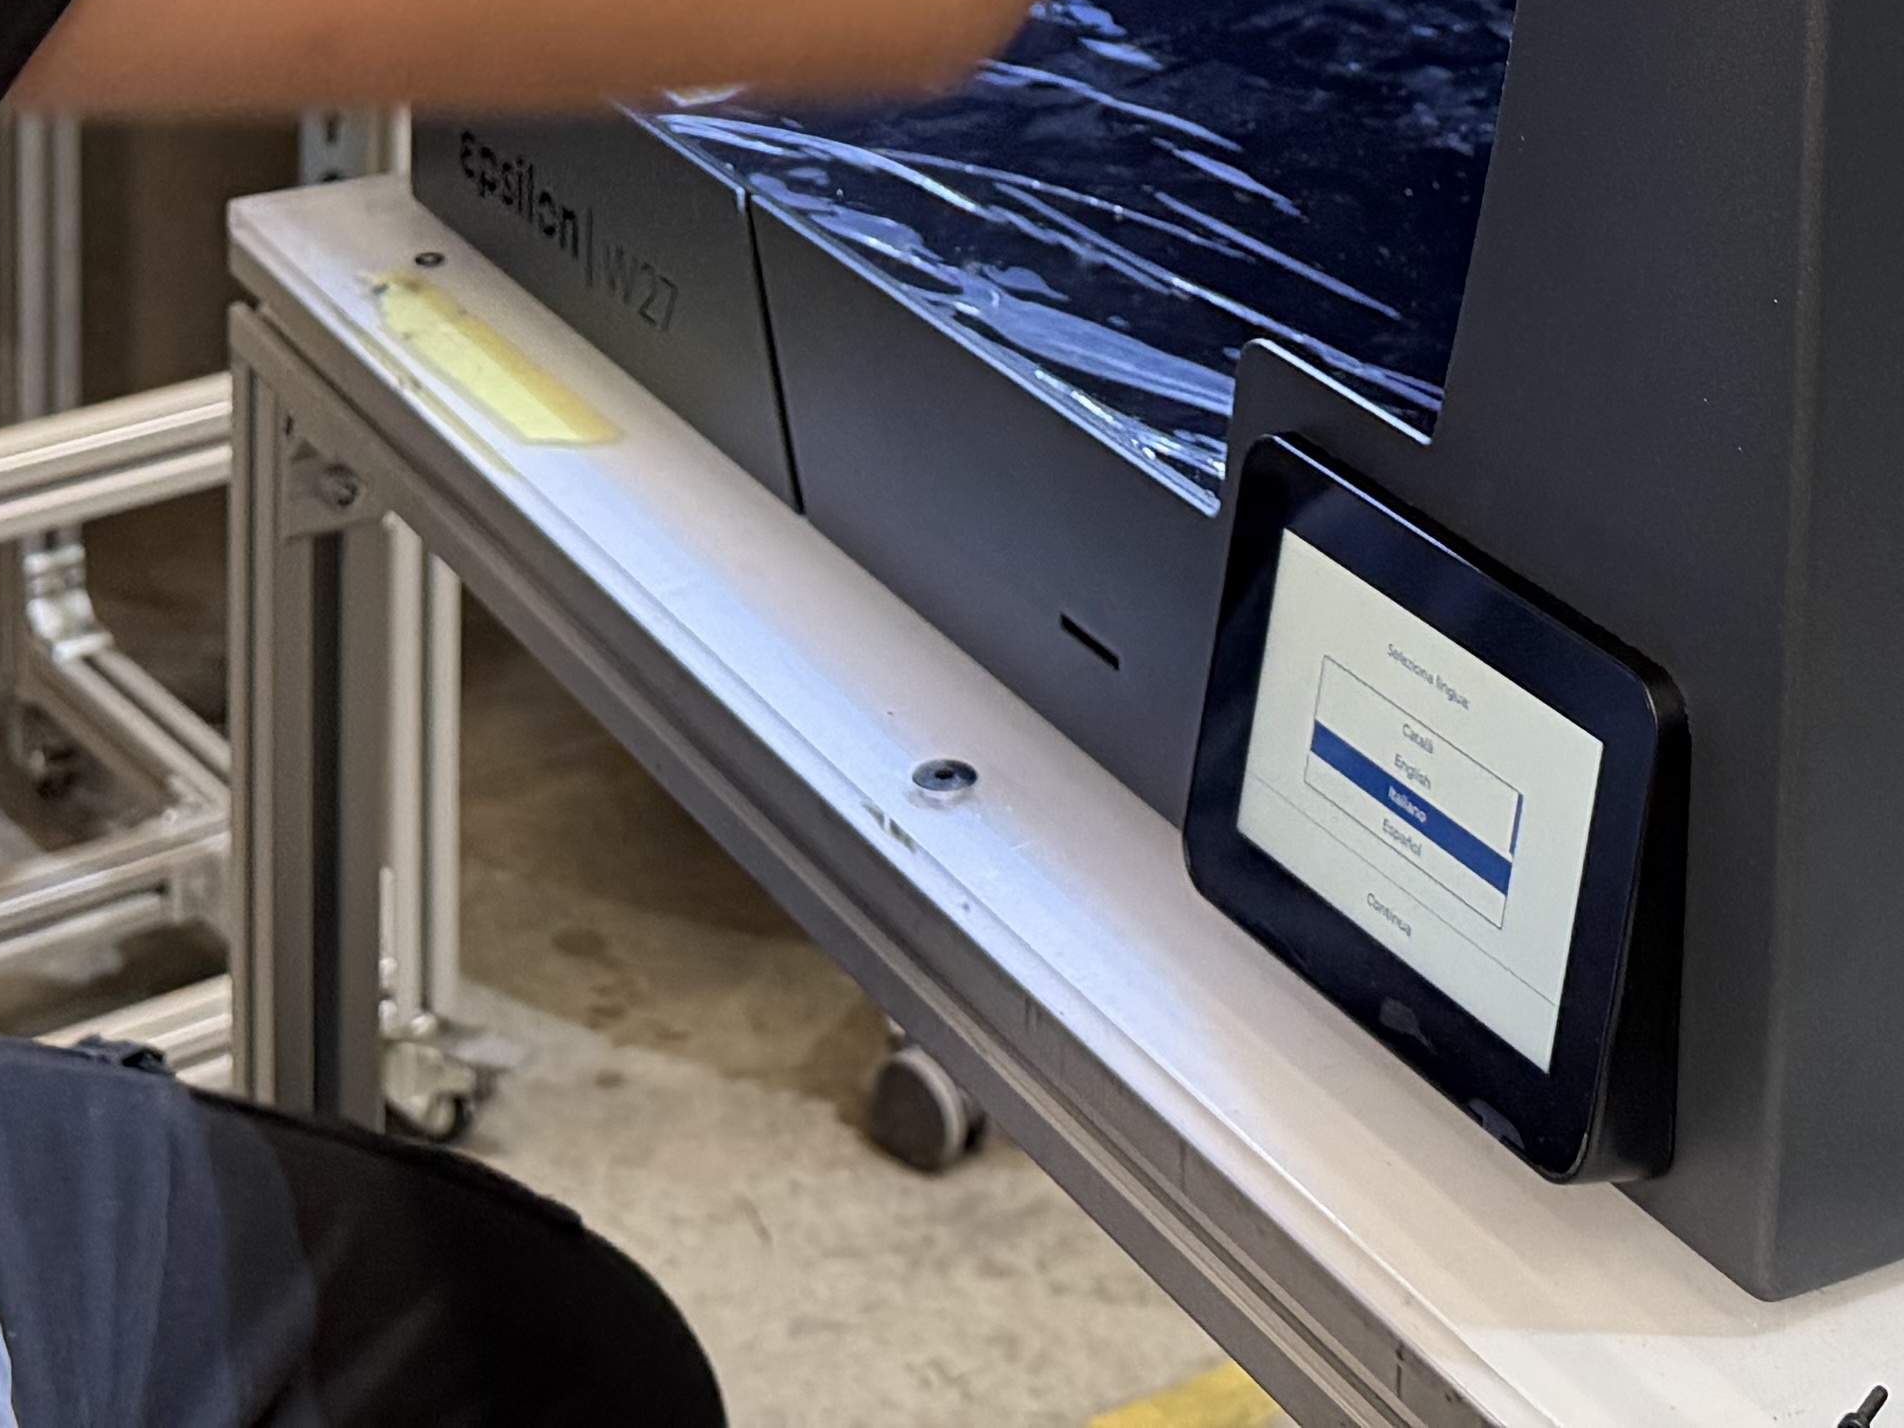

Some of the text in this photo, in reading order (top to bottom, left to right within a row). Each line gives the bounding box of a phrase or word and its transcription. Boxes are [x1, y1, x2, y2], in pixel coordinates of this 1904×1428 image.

[602, 244, 680, 332] W27
[1394, 753, 1431, 790] English
[1388, 785, 1427, 823] Italiano
[1366, 893, 1411, 937] Continua
